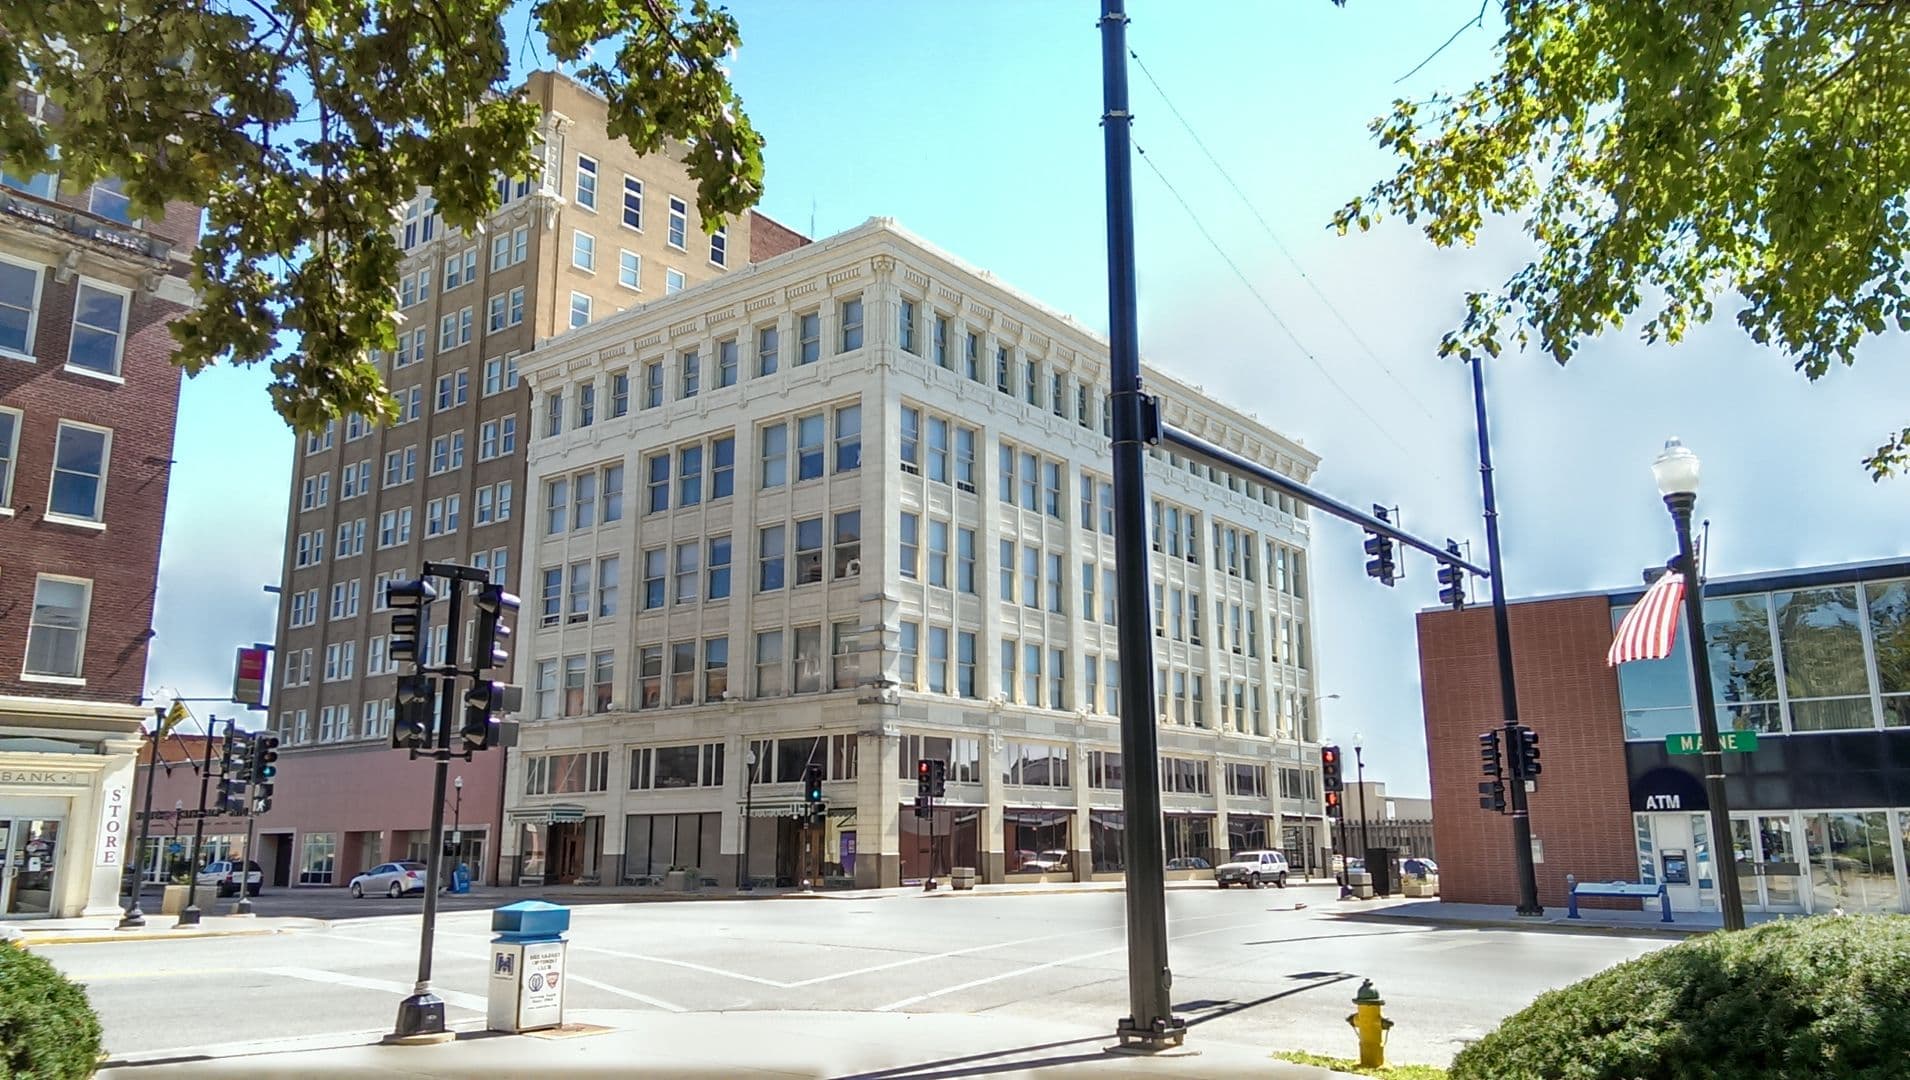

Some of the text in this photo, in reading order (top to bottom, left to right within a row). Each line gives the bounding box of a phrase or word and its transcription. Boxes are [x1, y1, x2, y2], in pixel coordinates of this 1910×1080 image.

[1680, 734, 1738, 751] MANE
[2, 771, 56, 782] BANK
[1646, 794, 1680, 809] ATM
[103, 789, 122, 863] STORE
